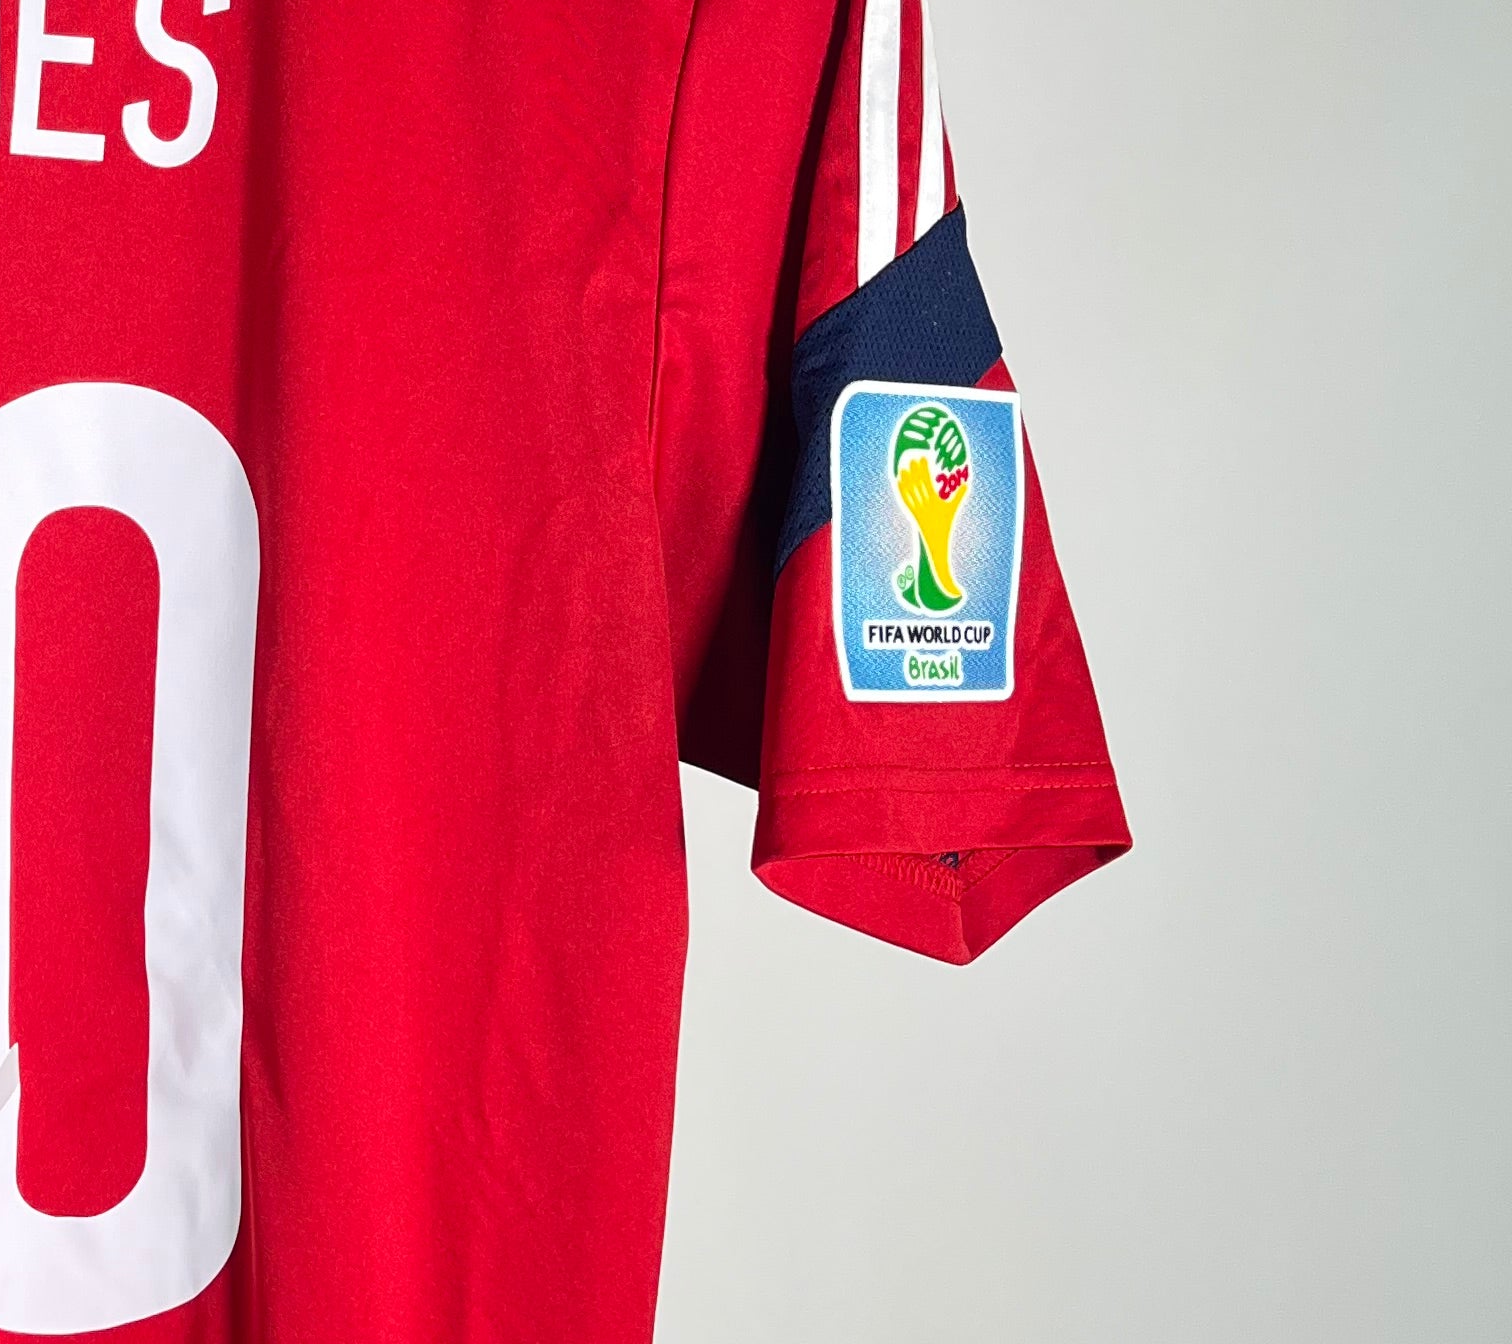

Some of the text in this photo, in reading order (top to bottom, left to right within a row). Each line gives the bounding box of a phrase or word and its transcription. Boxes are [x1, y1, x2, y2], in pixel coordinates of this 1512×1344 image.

[935, 464, 969, 500] 2014
[868, 625, 991, 644] FIFA WORLD CUP
[908, 655, 960, 681] Brasil
